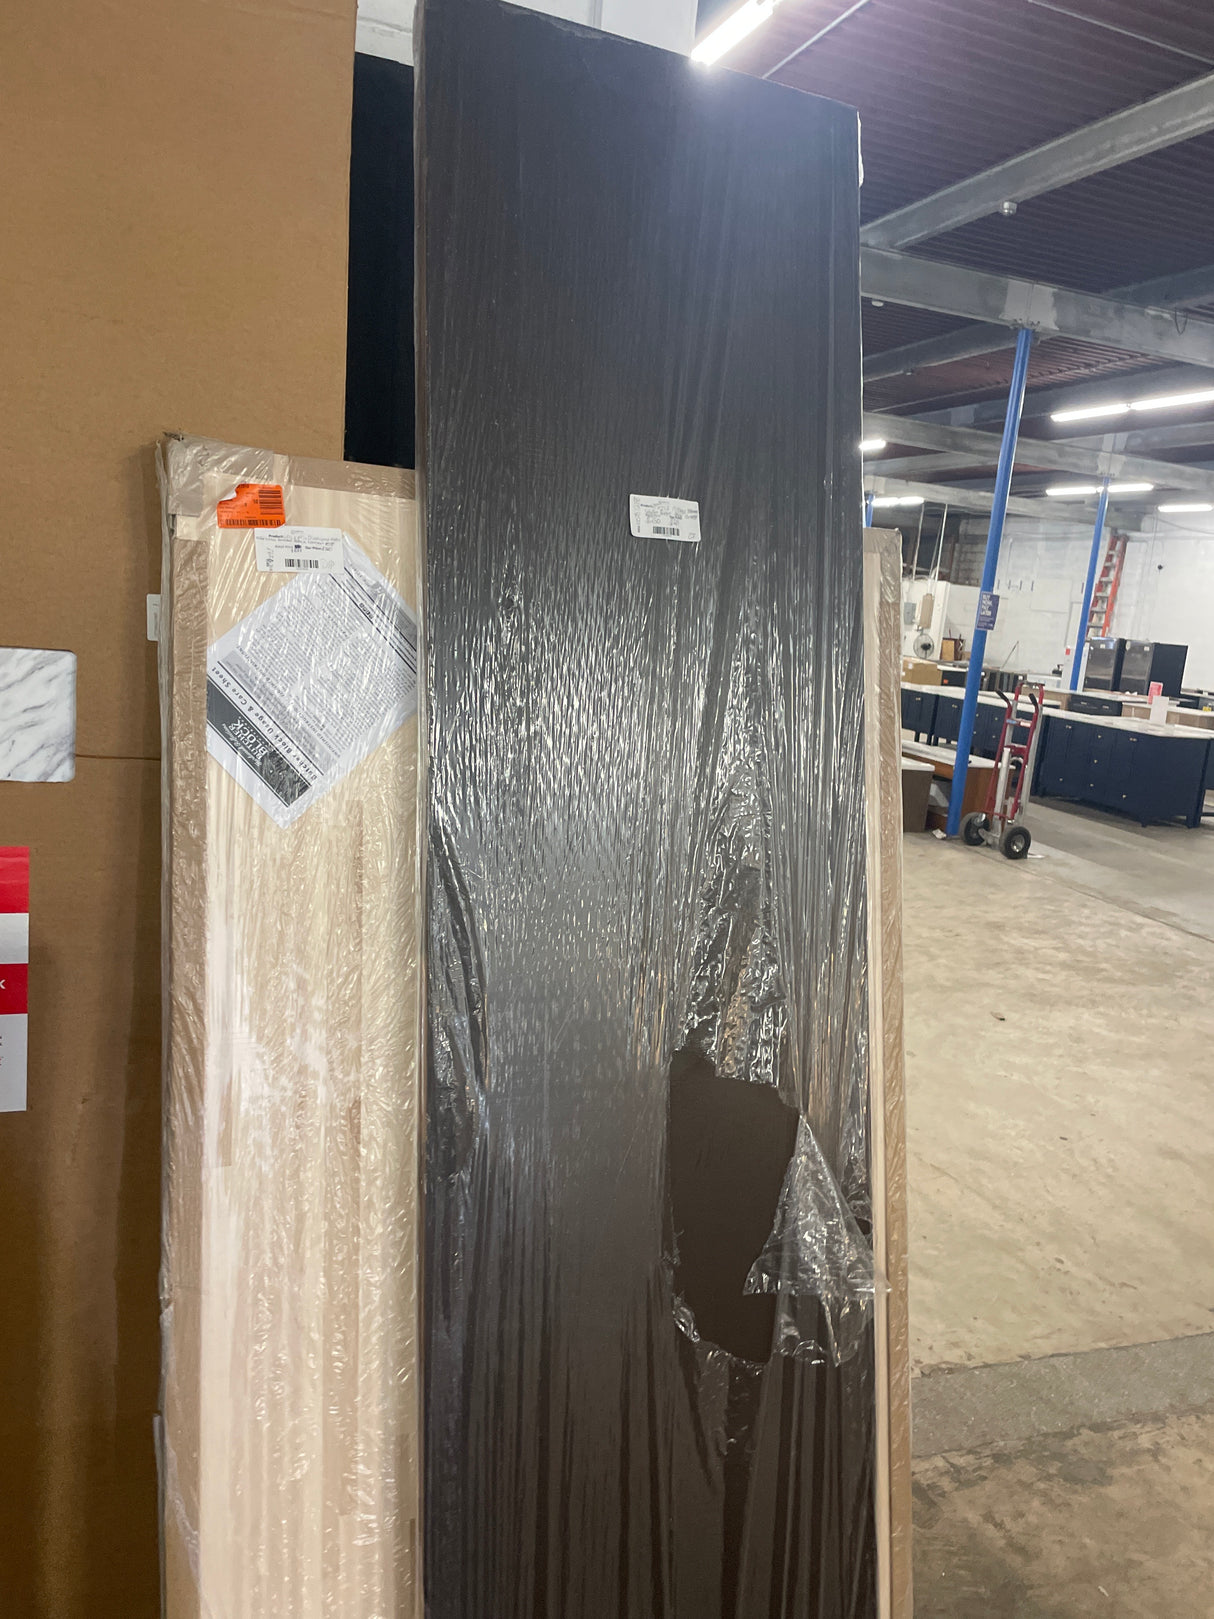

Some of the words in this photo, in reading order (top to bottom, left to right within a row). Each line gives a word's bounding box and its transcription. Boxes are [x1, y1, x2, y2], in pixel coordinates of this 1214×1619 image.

[210, 666, 231, 688] Sheet
[229, 687, 248, 706] Care
[246, 705, 254, 713] &
[252, 710, 275, 734] Usage
[227, 722, 263, 760] BUTCHER
[232, 718, 268, 756] BLOCK
[273, 733, 292, 754] Block
